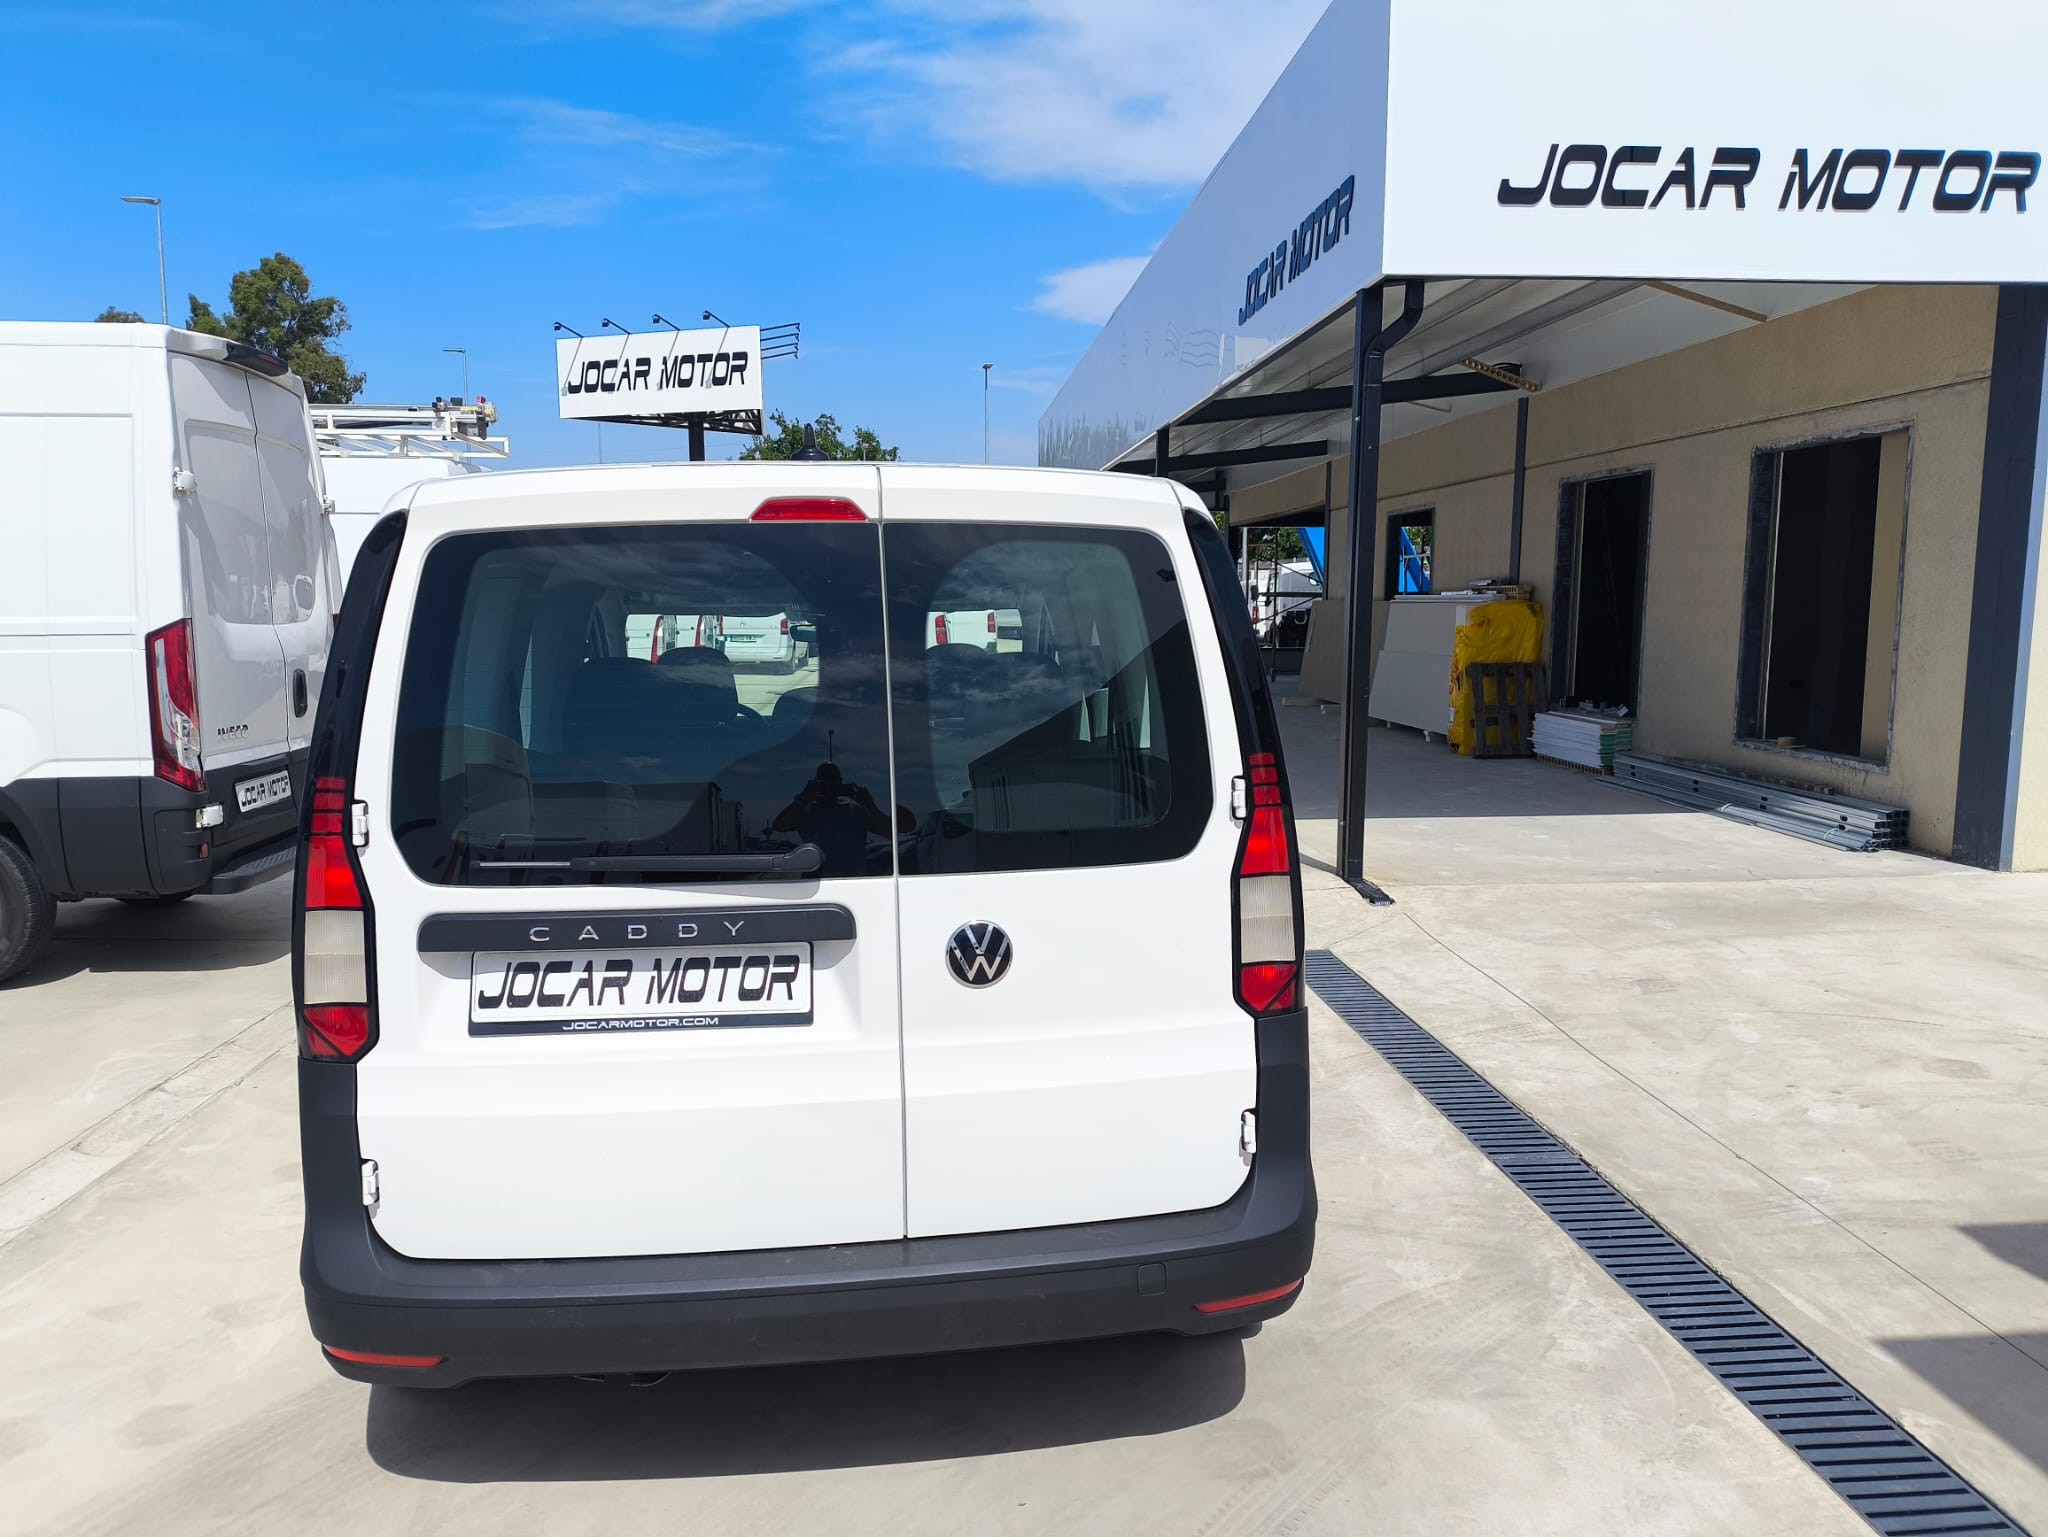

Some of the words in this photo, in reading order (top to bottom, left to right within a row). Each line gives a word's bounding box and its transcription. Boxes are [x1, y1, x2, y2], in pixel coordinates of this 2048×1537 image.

[1498, 144, 1761, 209] JOCAR
[1779, 148, 2042, 213] MOTOR
[1238, 240, 1287, 326] JOCAR
[1288, 174, 1355, 283] MOTOR
[568, 357, 651, 394] JOCAR
[659, 351, 748, 389] MOTOR
[241, 783, 266, 806] JOCAR
[528, 920, 746, 942] CADDY
[478, 959, 633, 1009] JOCAR
[645, 954, 800, 1005] MOTOR
[562, 1017, 719, 1031] JOCARMOTOR.COM
